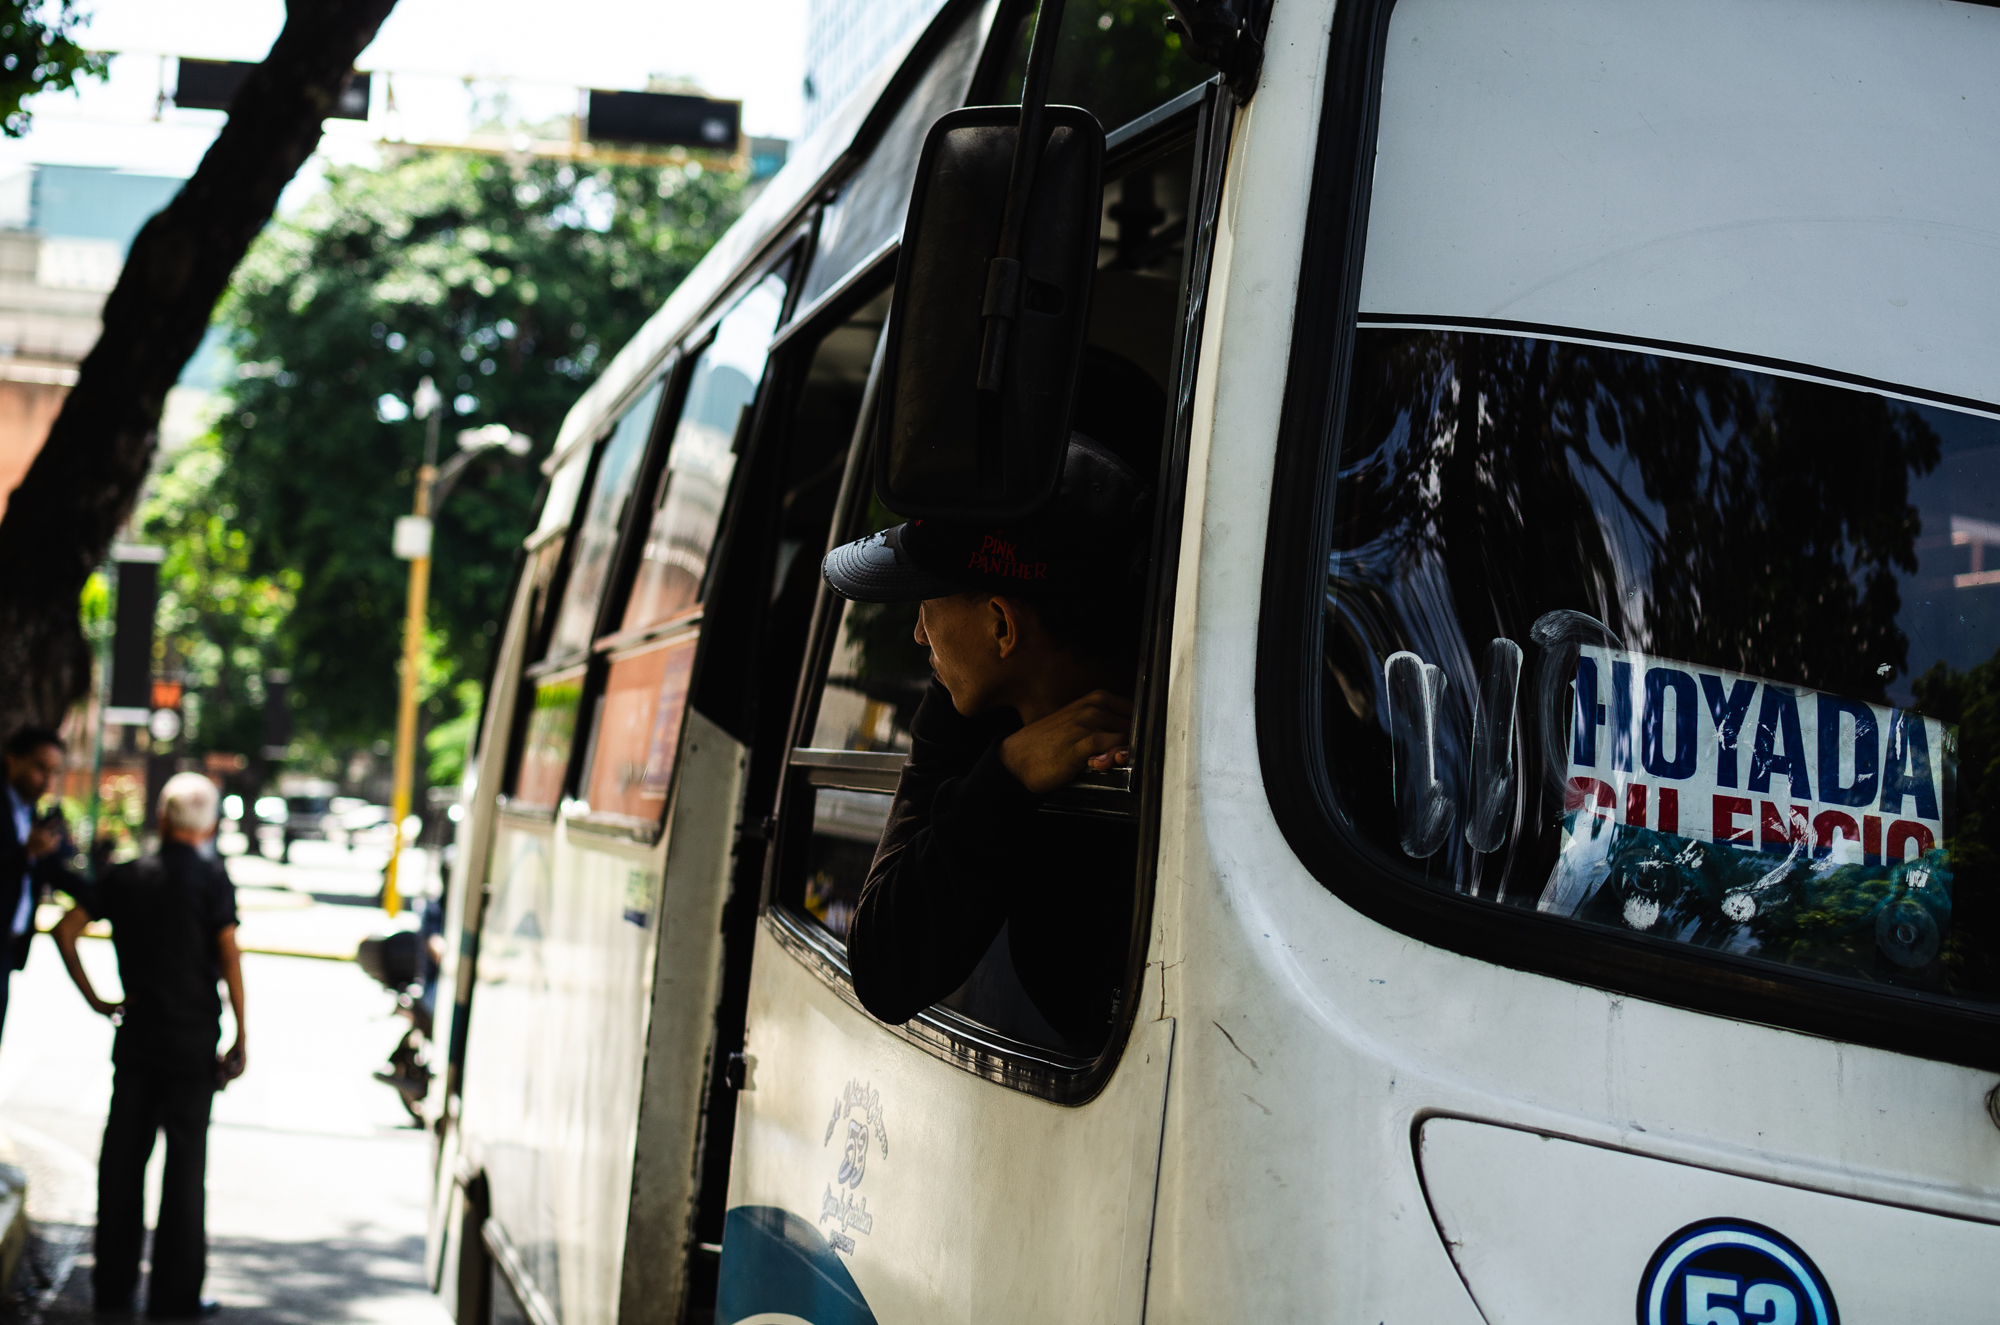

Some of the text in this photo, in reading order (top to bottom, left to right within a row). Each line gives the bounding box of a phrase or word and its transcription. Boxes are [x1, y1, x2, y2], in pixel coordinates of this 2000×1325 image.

[968, 551, 1047, 580] PANTHER
[980, 535, 1018, 561] PINK
[1574, 655, 1940, 821] HOYADA
[1685, 1273, 1798, 1325] 53
